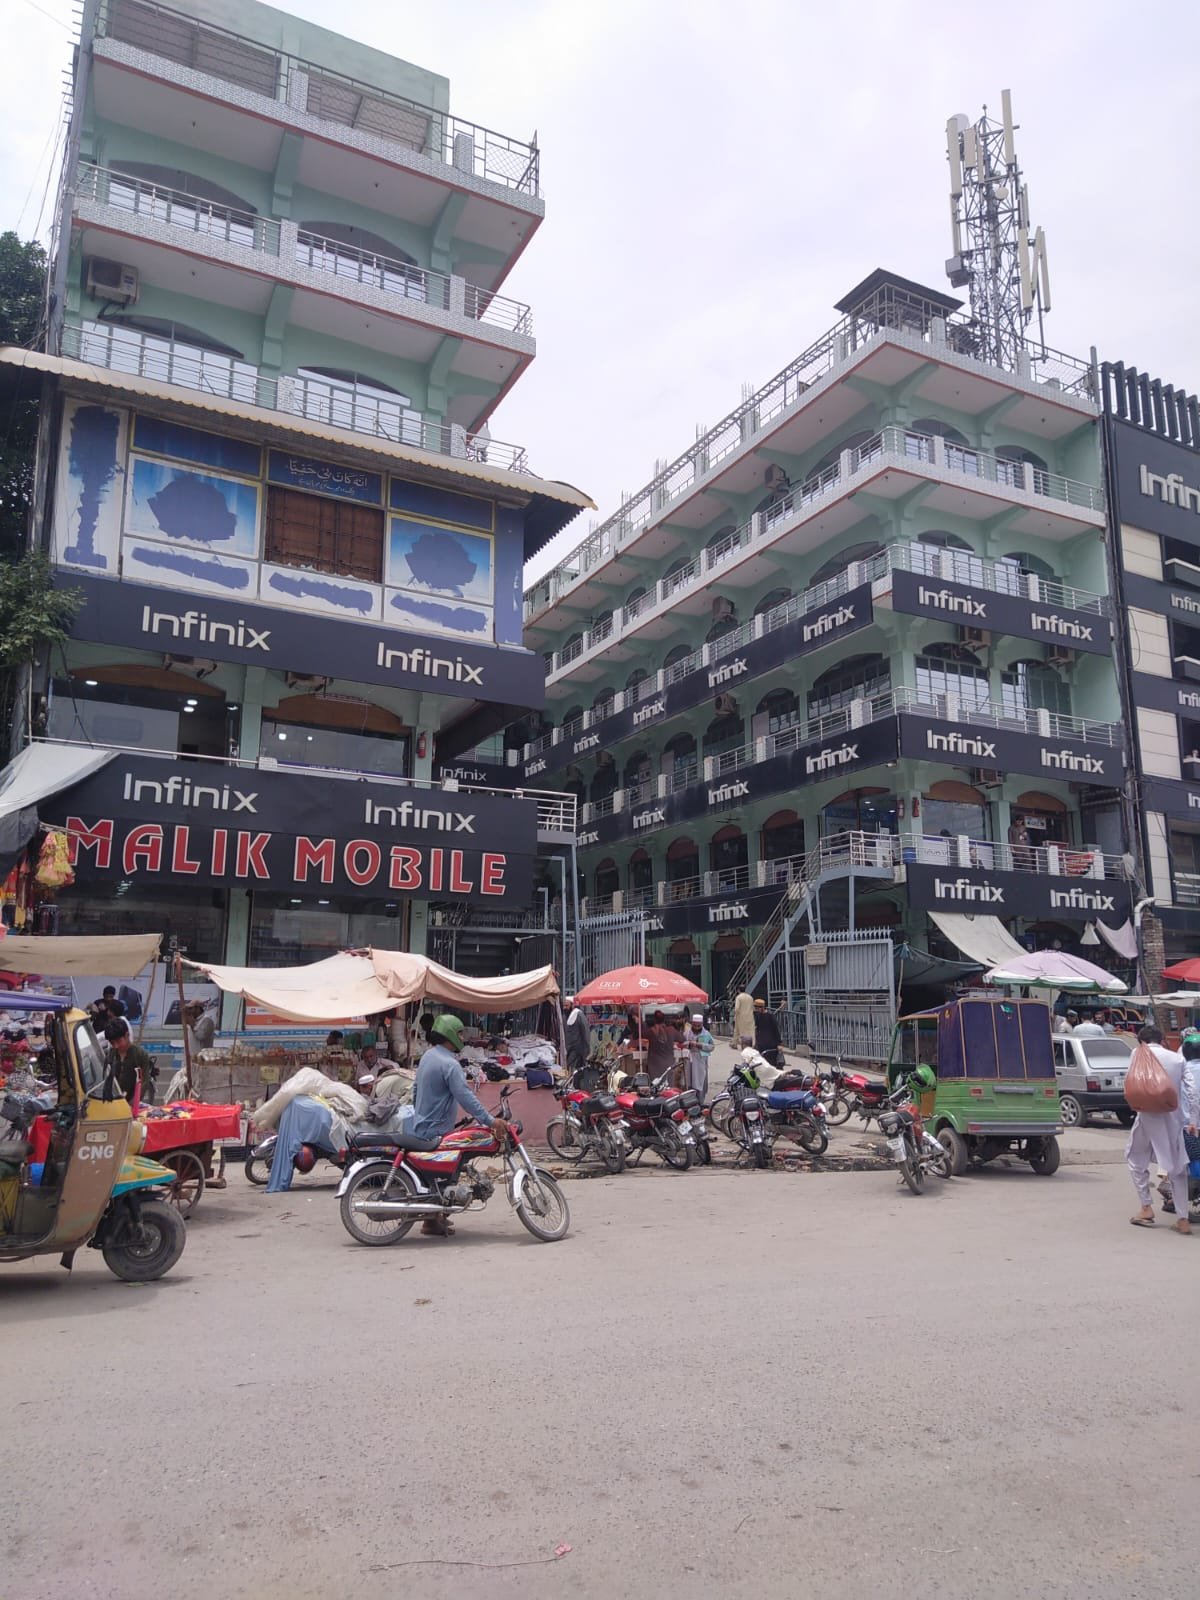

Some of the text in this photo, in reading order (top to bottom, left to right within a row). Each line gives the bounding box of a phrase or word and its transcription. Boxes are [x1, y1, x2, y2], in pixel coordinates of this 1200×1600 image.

[919, 586, 987, 619] Infinix
[142, 605, 272, 652] Infinix
[803, 603, 857, 643] Infinix
[1031, 613, 1094, 642] Infinix
[377, 641, 485, 685] Infinix
[708, 657, 748, 688] Infinix
[633, 699, 665, 726] Infinix
[573, 732, 600, 754] Infinix
[927, 730, 998, 759] Infinix
[440, 766, 487, 781] Infinix
[525, 758, 547, 778] Infinix
[806, 744, 860, 775] Infinix
[1041, 748, 1105, 775] Infinix
[123, 773, 259, 814] Infinix
[708, 779, 750, 805] Infinix
[364, 798, 476, 834] Infinix
[633, 808, 665, 829] Infinix
[65, 815, 507, 896] MALIK MOBILE
[935, 878, 1006, 904] Infinix
[1050, 888, 1116, 911] Infinix
[708, 901, 749, 923] Infinix
[78, 1145, 115, 1160] CNG
